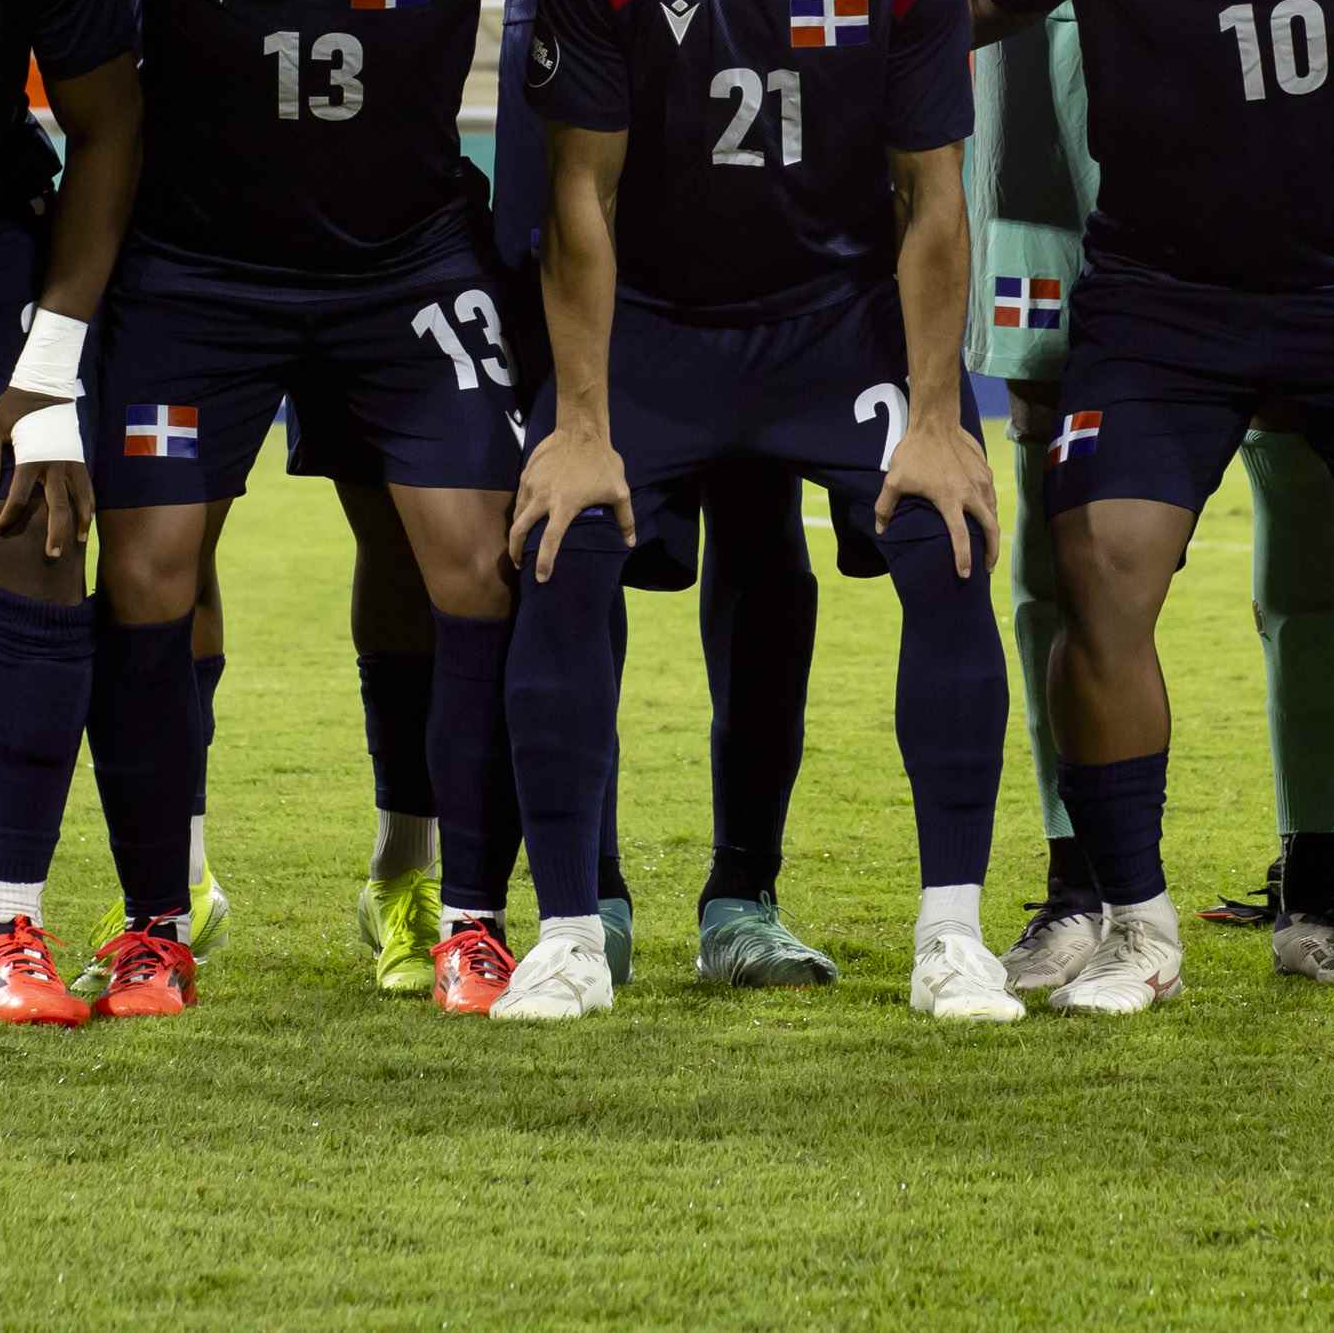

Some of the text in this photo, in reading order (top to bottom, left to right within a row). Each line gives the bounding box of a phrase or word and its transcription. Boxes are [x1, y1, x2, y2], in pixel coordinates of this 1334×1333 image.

[263, 29, 365, 122] 13
[709, 66, 804, 168] 21
[410, 288, 517, 391] 13
